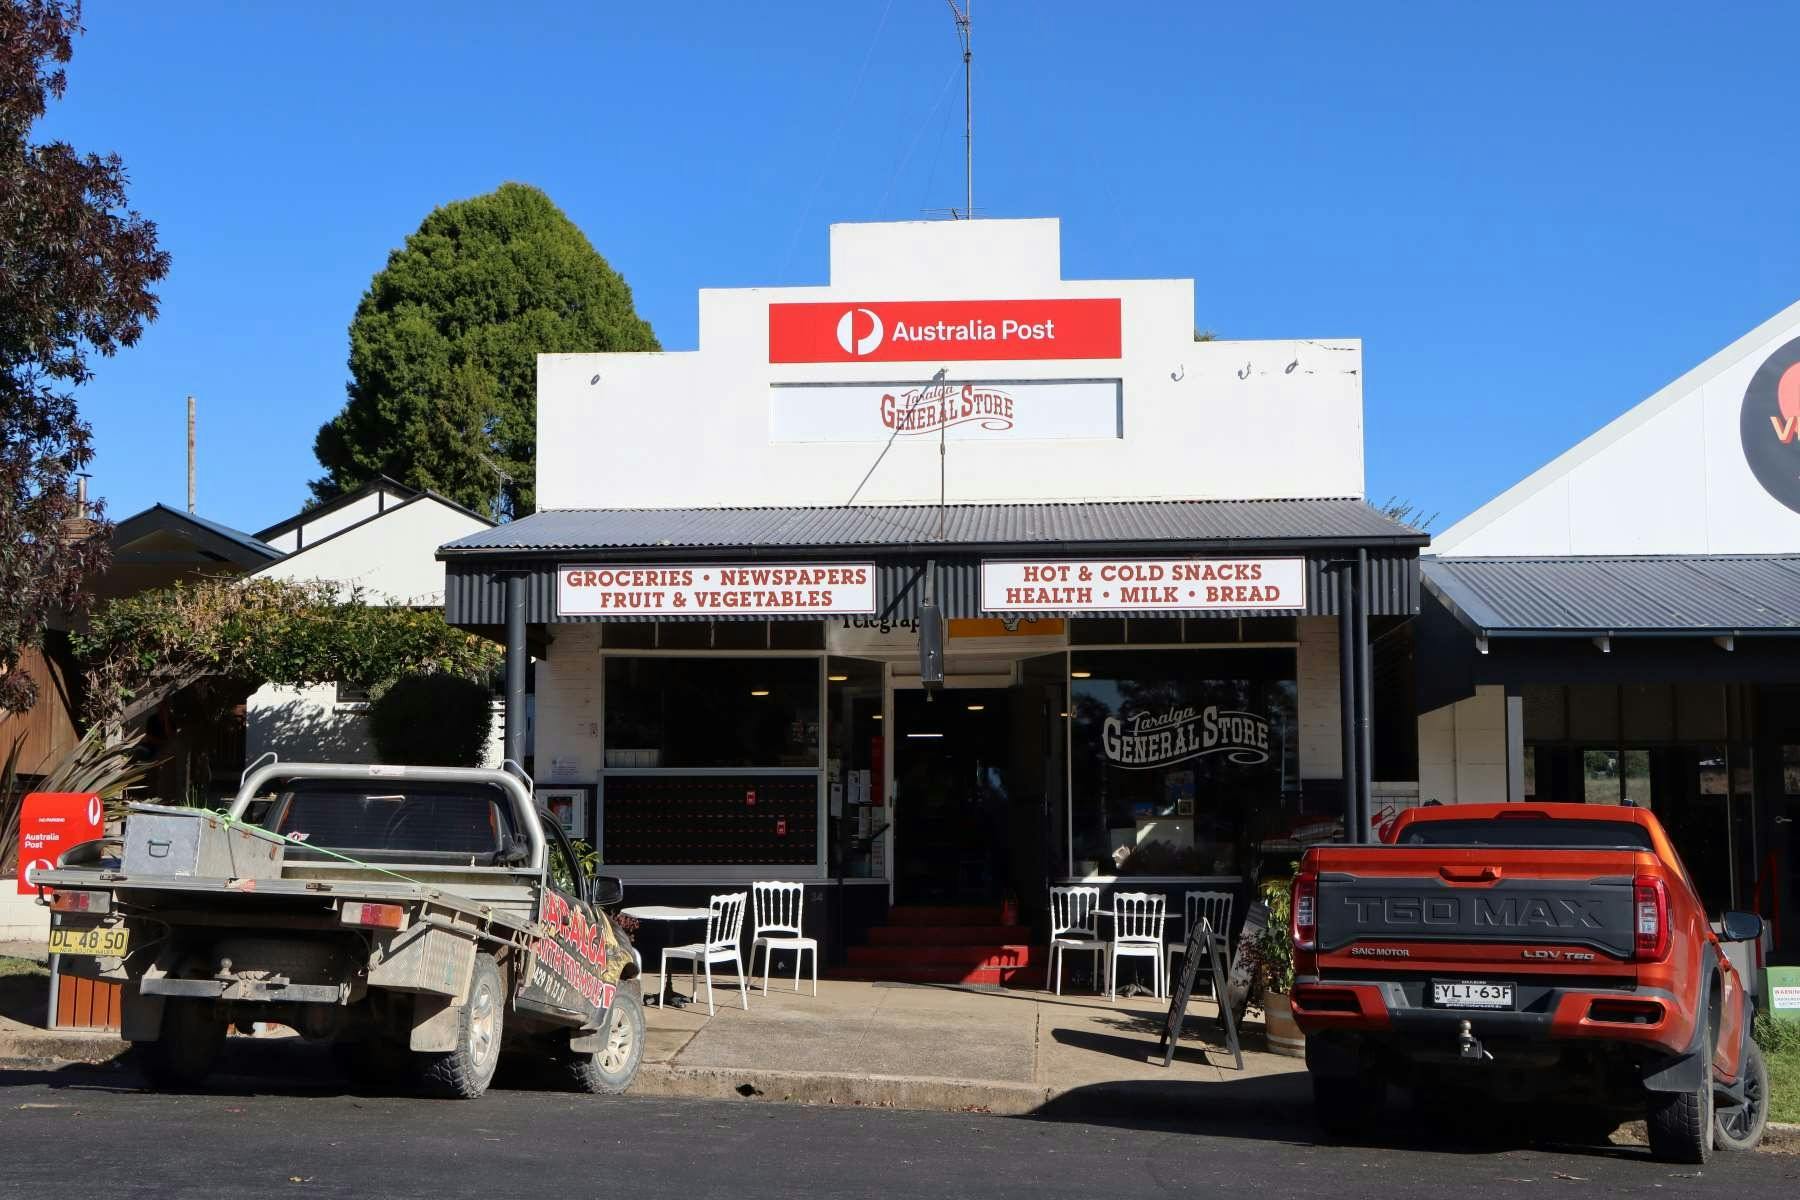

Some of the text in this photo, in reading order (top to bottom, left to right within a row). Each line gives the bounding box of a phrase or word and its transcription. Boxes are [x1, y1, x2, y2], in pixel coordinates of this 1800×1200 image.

[892, 319, 1055, 342] Australia Post
[961, 384, 1014, 419] STORE
[566, 569, 867, 587] GROCERIES NEWSPAPERS
[1023, 564, 1262, 583] HOT & COLD SNACKS
[600, 590, 832, 609] FRUIT & VEGETABLES
[1006, 585, 1280, 604] HEALTH MILK BREAD
[843, 617, 921, 633] Telegrap
[1128, 706, 1195, 735] Taralga
[1102, 706, 1269, 764] GENERAL STORE
[25, 833, 59, 841] Australia
[25, 840, 43, 849] Post
[1345, 897, 1603, 929] T60 MAX
[1352, 947, 1410, 957] SAIC MOTOR
[1523, 950, 1561, 959] LDV
